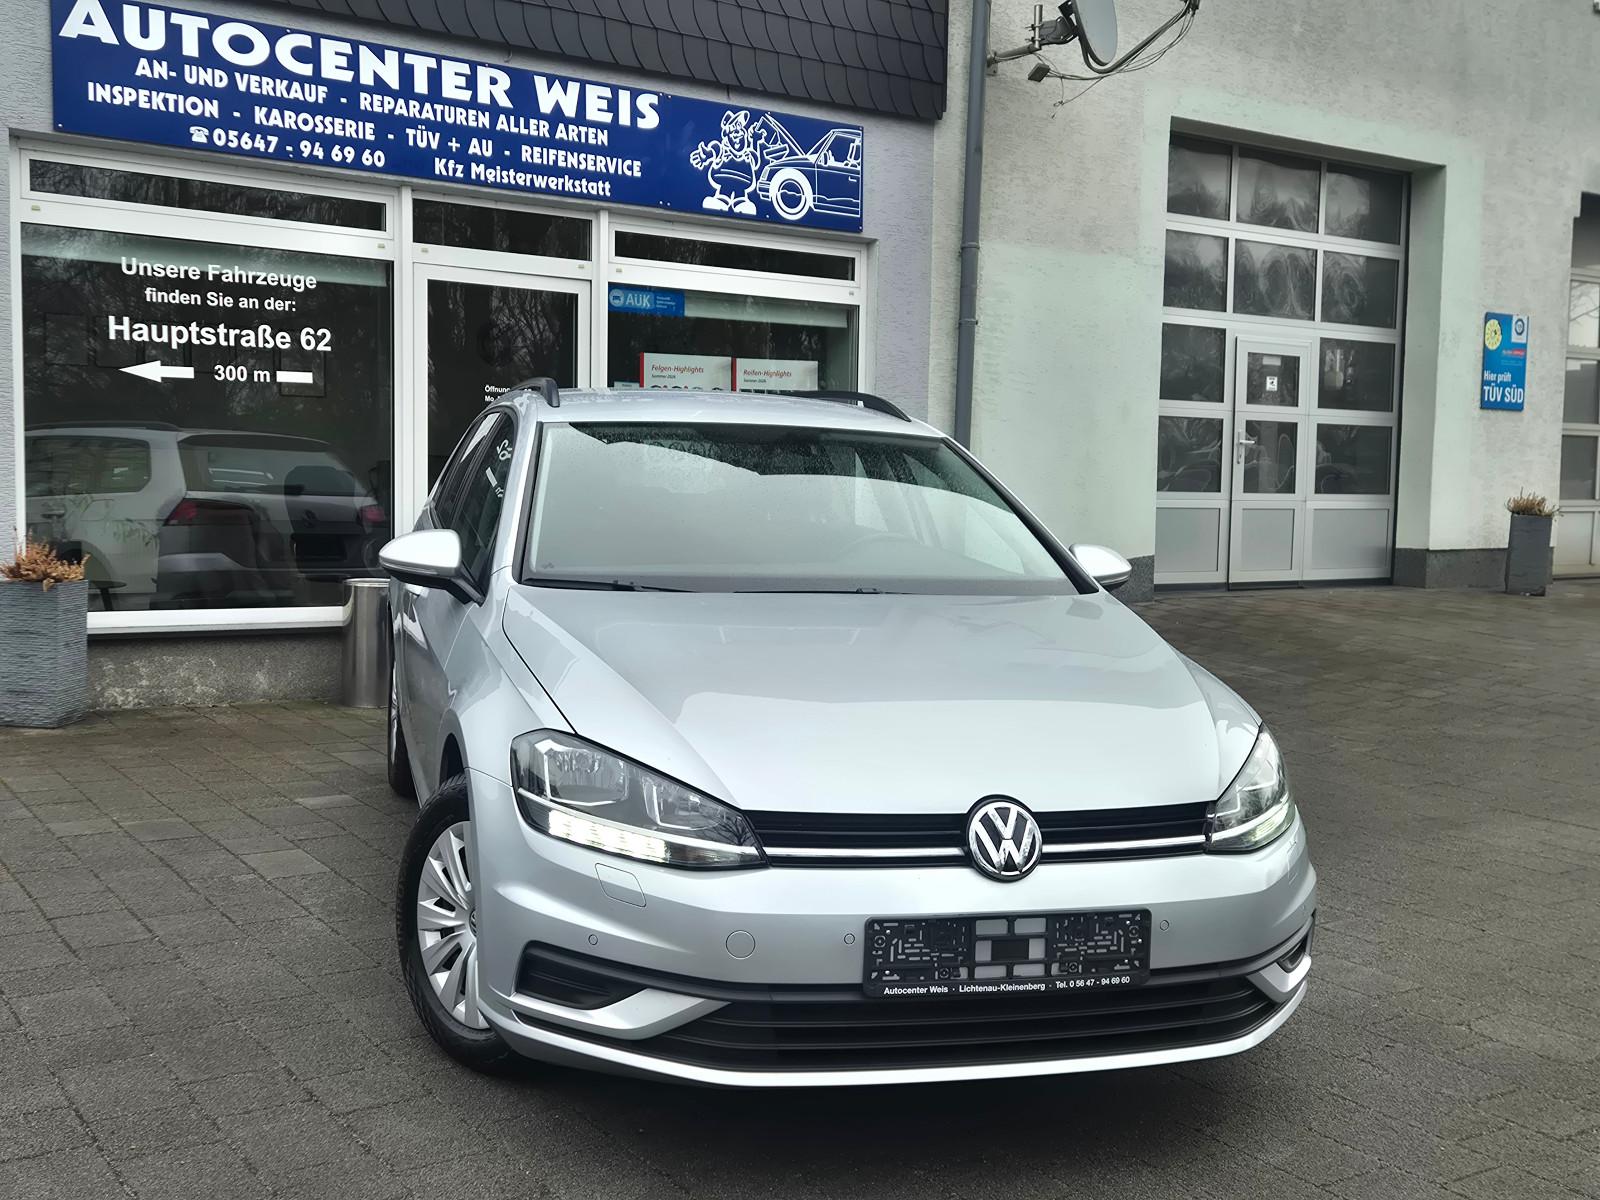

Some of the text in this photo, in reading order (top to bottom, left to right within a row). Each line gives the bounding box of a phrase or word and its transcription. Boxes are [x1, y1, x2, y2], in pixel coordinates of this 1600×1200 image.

[58, 0, 660, 130] AUTOCENTER WEIS
[134, 57, 177, 81] AN-
[183, 64, 229, 88] UND
[234, 71, 328, 104] VERKAUF
[359, 91, 490, 129] REPARATUREN
[495, 113, 550, 138] ALLER
[554, 122, 609, 147] ARTEN
[87, 81, 219, 119] INSPEKTION
[253, 105, 376, 141] KAROSSERIE
[405, 124, 441, 150] TÜV
[447, 137, 461, 152] +
[467, 137, 493, 157] AU
[520, 144, 642, 177] REIFENSERVICE
[212, 128, 279, 153] 05647
[299, 139, 325, 160] 94
[330, 144, 355, 163] 69
[361, 148, 386, 168] 60
[433, 156, 612, 197] Kfz Meisterwerkstatt
[120, 256, 318, 293] Unsere Fahrzeuge
[144, 286, 297, 312] finden Sie an der:
[107, 315, 332, 351] Hauptstraße 62
[213, 364, 271, 383] 300 m
[651, 363, 705, 375] Felgen-Highlights
[743, 368, 793, 379] Reifen-Highlights
[1483, 369, 1512, 384] Hier prüft
[1483, 382, 1524, 404] TÜV SÜD
[968, 801, 1043, 876] VW
[883, 986, 928, 995] Autocenter
[929, 985, 949, 993] Weis
[959, 982, 1046, 993] Lichtenau-Kleinenberg
[1055, 980, 1068, 989] Tel.
[1069, 980, 1075, 988] 0
[1075, 979, 1085, 988] 56
[1085, 979, 1095, 987] 47
[1101, 978, 1110, 986] 94
[1111, 977, 1120, 985] 69
[1121, 976, 1130, 984] 60
